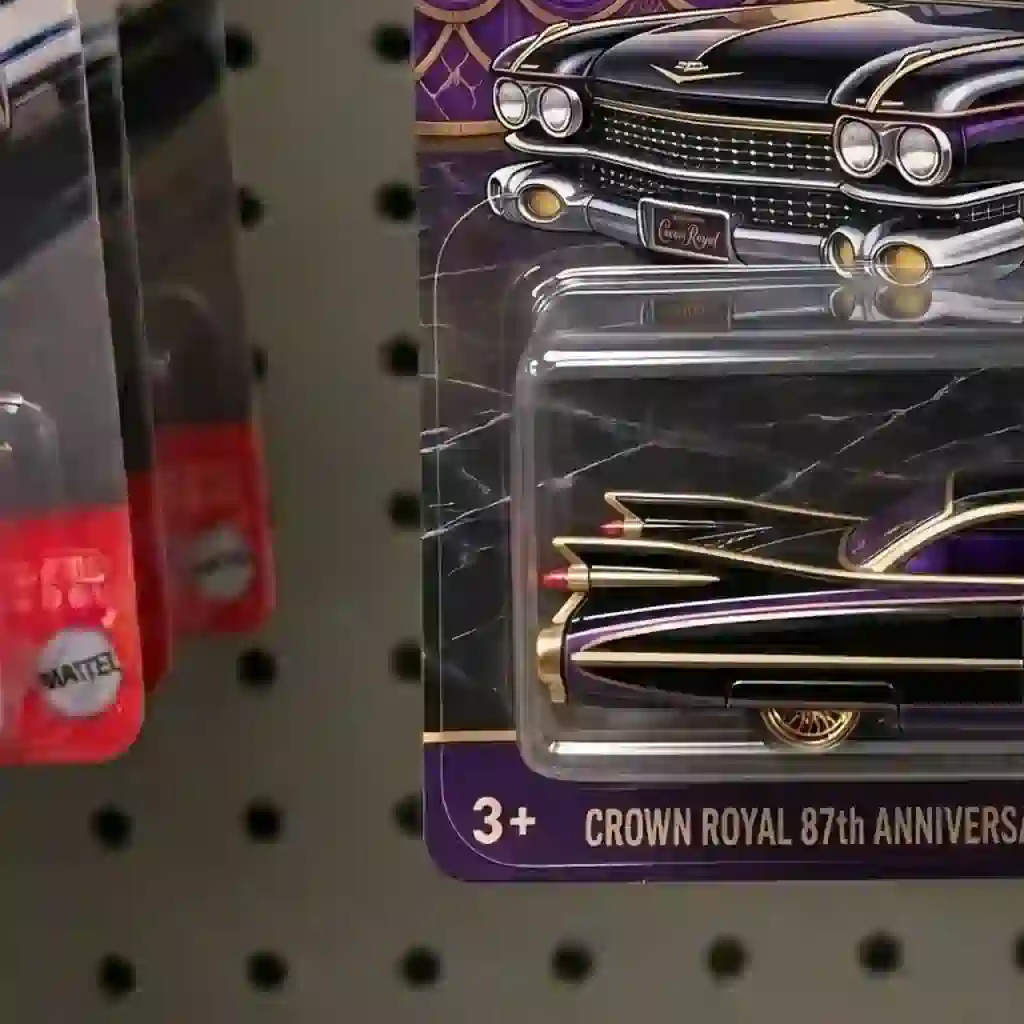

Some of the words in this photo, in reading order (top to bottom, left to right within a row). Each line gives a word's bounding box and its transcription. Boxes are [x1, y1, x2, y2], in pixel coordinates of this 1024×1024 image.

[39, 652, 121, 689] MATTEL
[472, 796, 536, 845] 3+
[585, 807, 692, 846] CROWN
[702, 807, 792, 846] ROYAL
[800, 807, 864, 846] 87th
